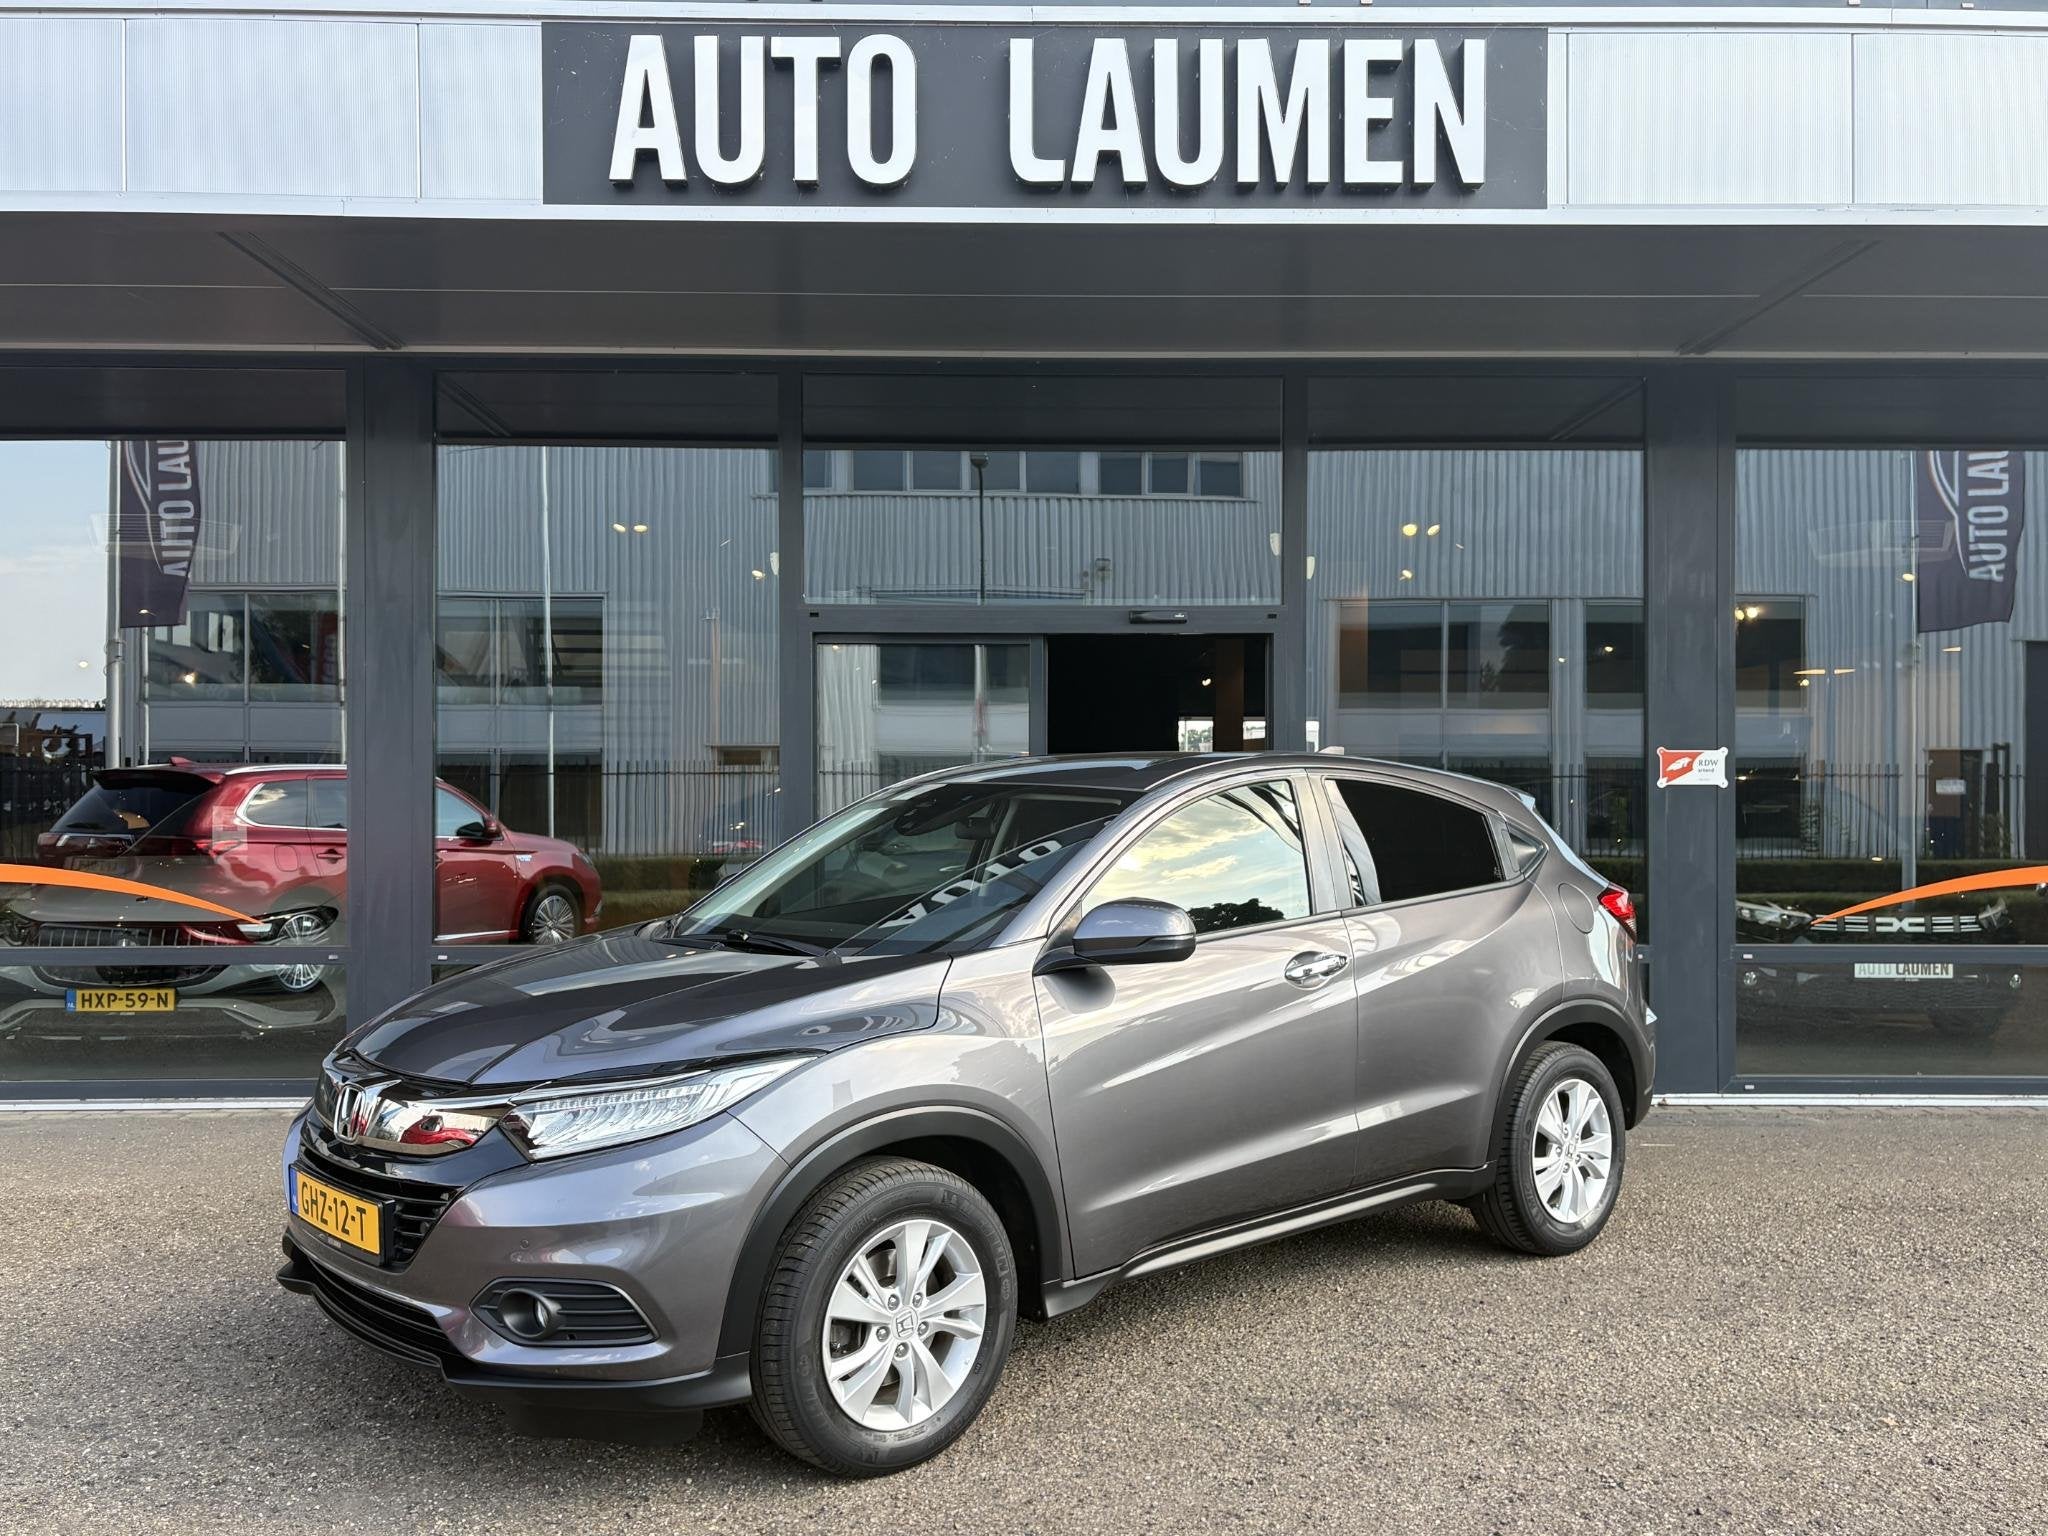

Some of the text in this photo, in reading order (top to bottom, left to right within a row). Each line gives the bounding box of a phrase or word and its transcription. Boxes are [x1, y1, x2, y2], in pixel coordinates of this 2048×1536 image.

[609, 33, 1487, 190] AUTO LAUMEN
[158, 500, 195, 577] AUTO
[1967, 505, 2009, 582] AUTO
[1698, 759, 1719, 767] RDW
[1895, 963, 1950, 976] LAUMEN
[81, 992, 169, 1009] HXP-59-N
[301, 1181, 367, 1242] GHZ-12-T
